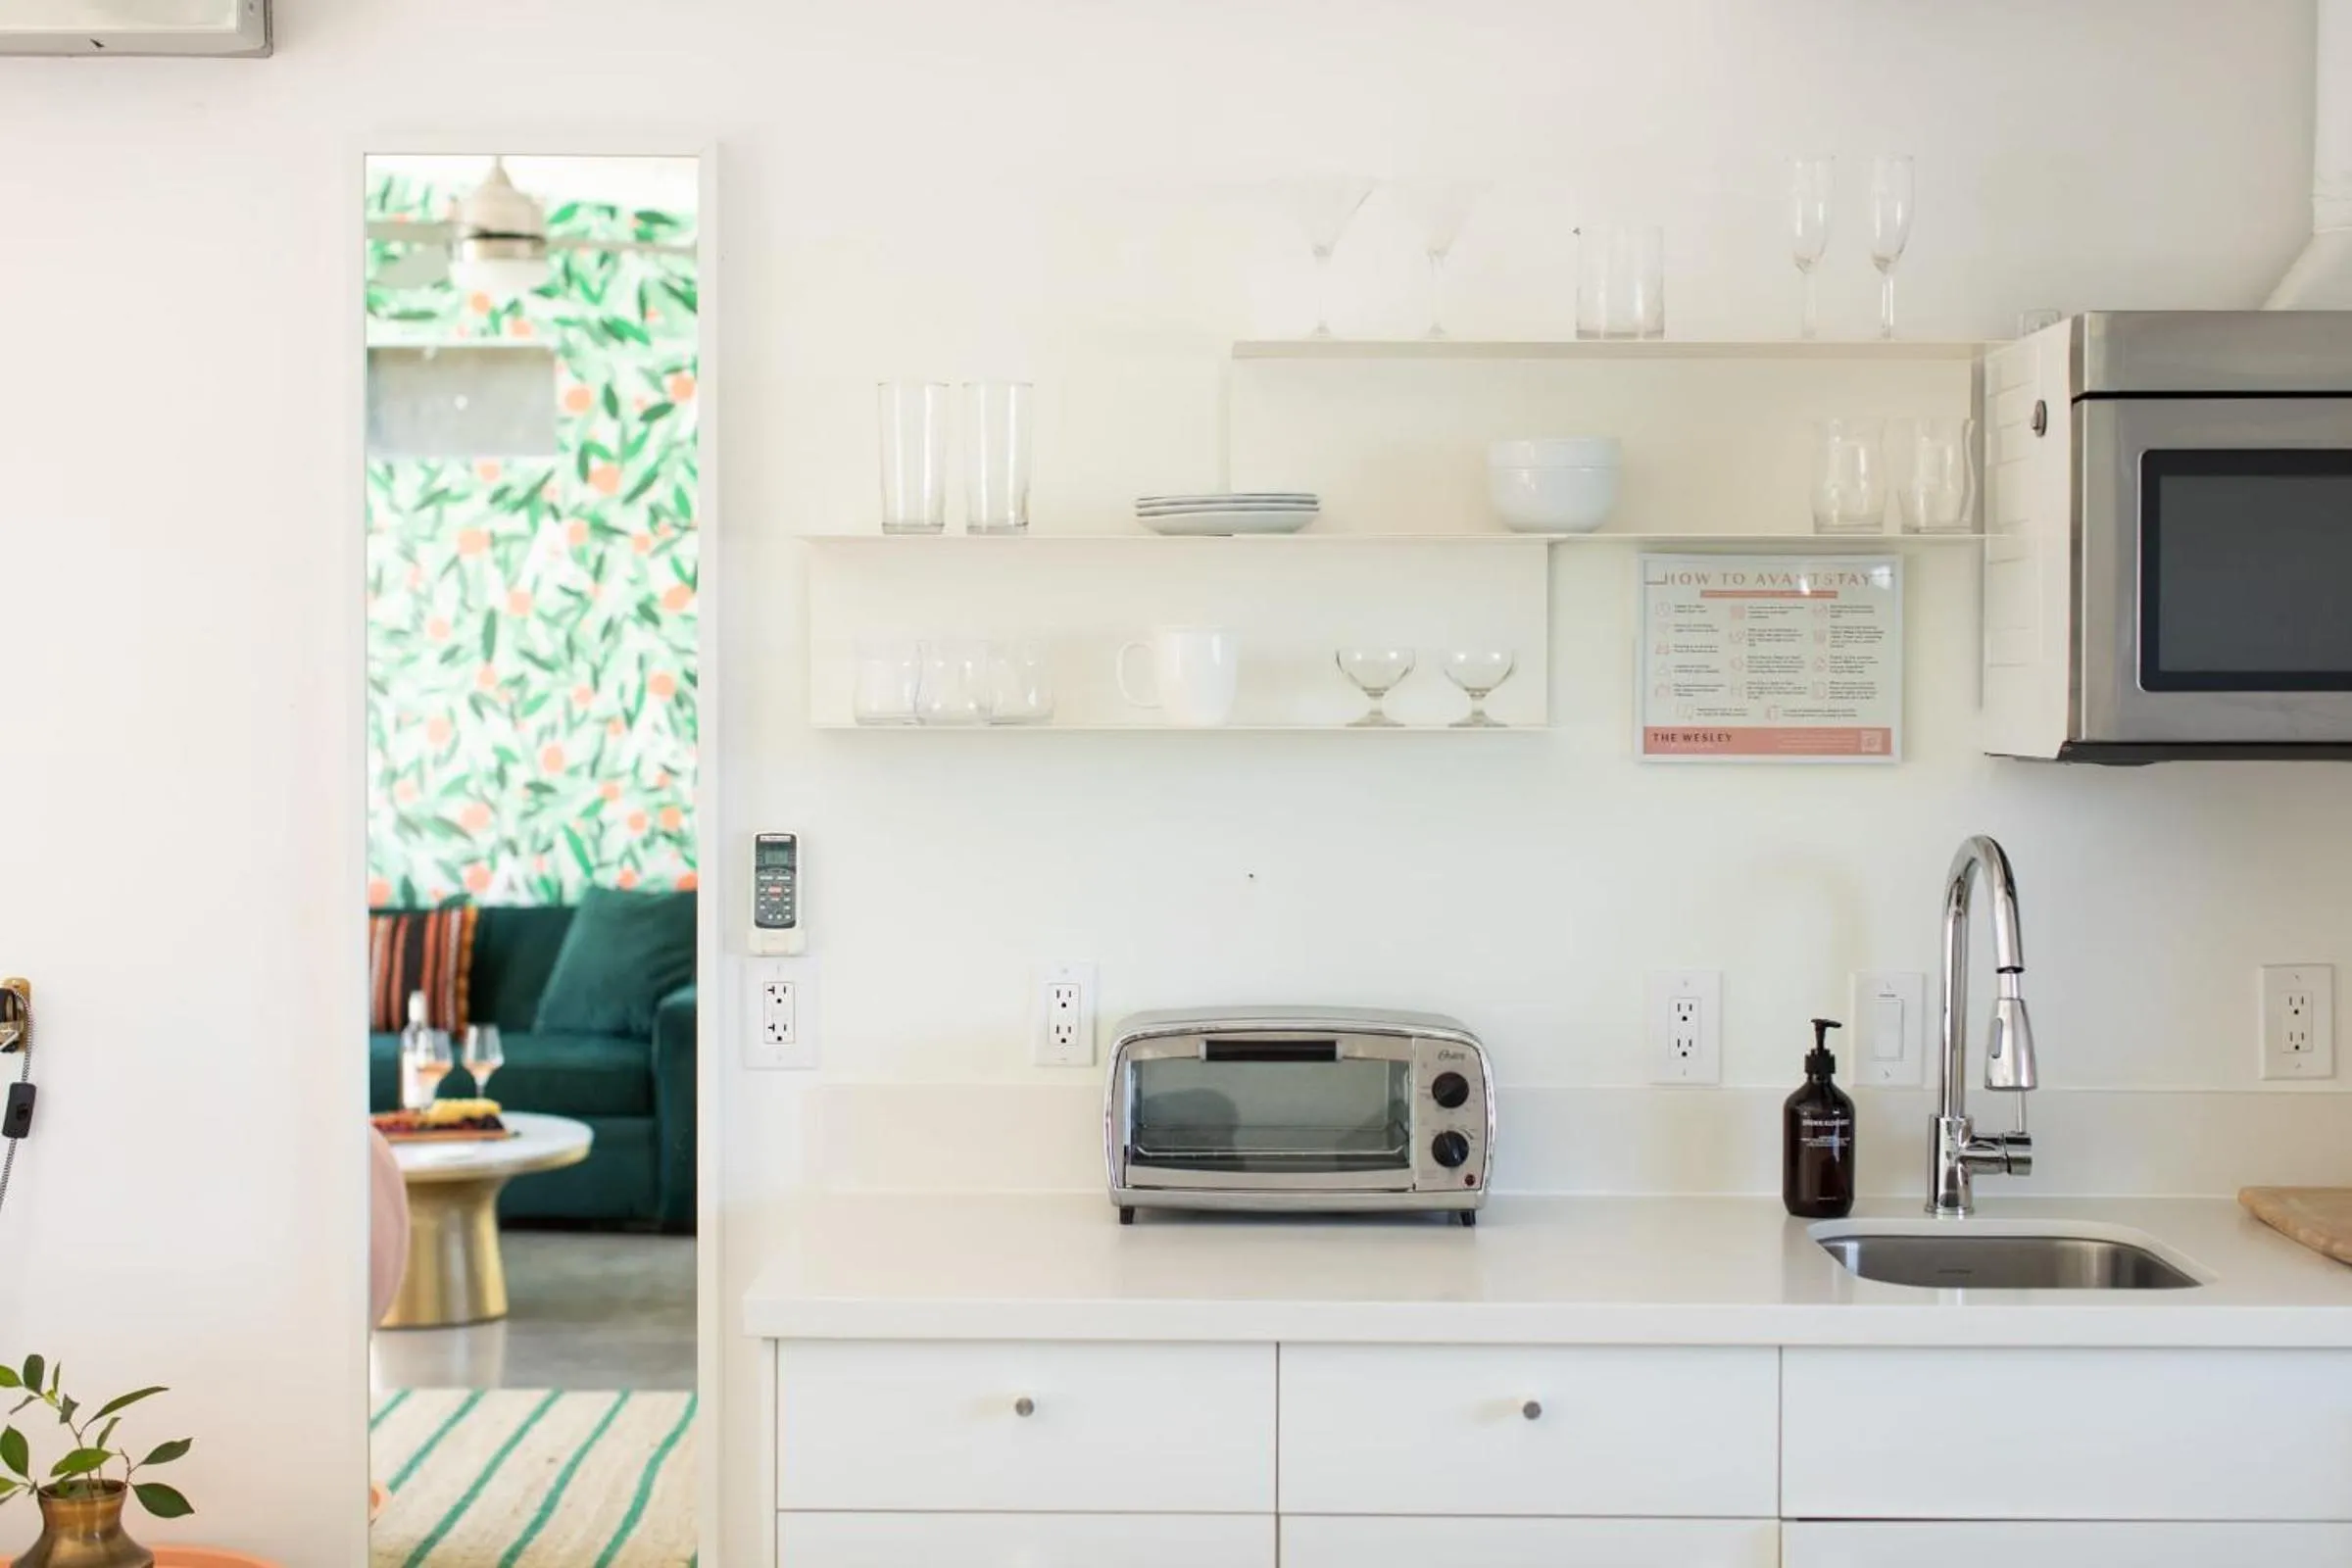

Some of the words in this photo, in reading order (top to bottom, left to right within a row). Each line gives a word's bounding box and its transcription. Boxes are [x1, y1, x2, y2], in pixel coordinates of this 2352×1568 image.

[1720, 572, 1745, 585] TO
[1653, 733, 1678, 743] THE
[1683, 733, 1733, 743] WESLEY
